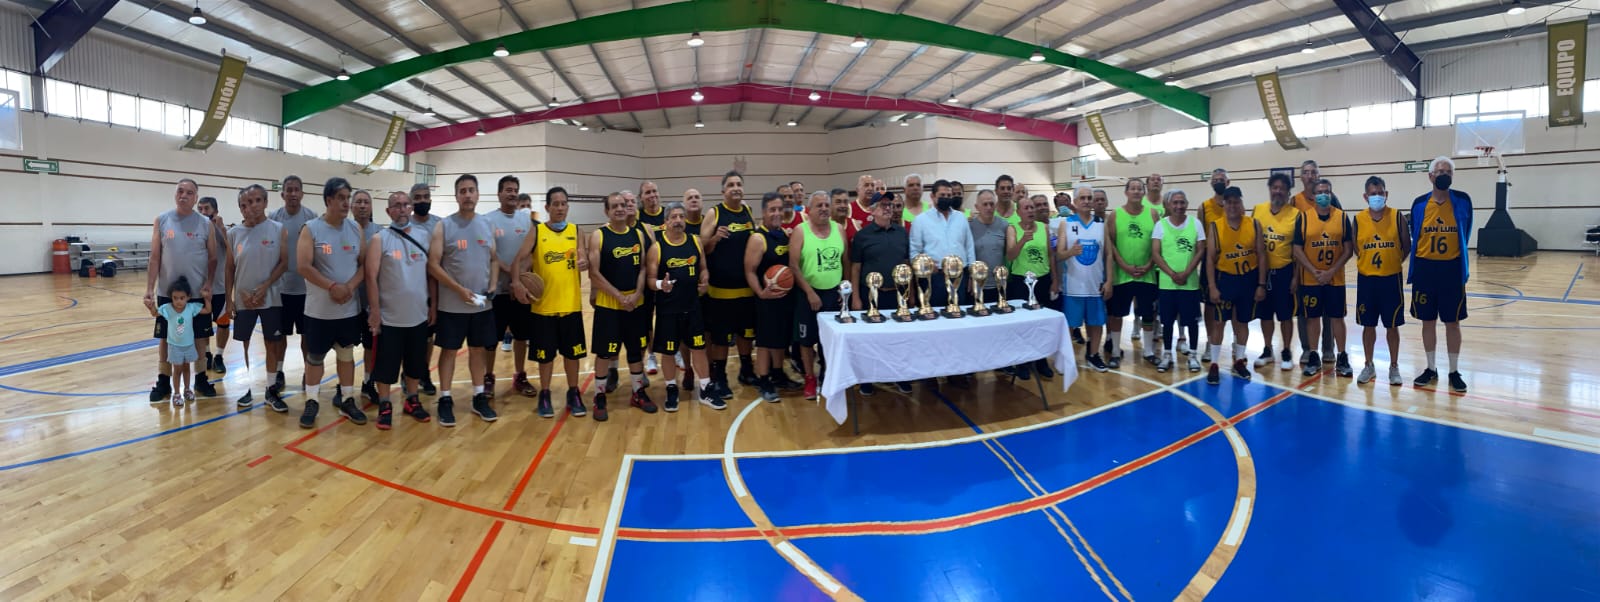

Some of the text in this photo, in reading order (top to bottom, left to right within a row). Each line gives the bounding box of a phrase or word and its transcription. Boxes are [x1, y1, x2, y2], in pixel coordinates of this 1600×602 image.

[1557, 39, 1576, 96] EQUIPO
[213, 76, 238, 120] UNIÓN
[1262, 79, 1287, 132] ESFUERZO
[1071, 225, 1079, 236] 4
[322, 243, 332, 255] 16
[457, 239, 468, 249] 10
[1430, 235, 1448, 255] 16
[1225, 252, 1240, 260] SAN
[1317, 249, 1335, 266] 49
[1371, 251, 1383, 269] 4
[1234, 260, 1251, 275] 10
[1415, 291, 1428, 305] 16
[1359, 304, 1366, 315] 4
[608, 342, 618, 353] 12
[666, 341, 675, 351] 11
[693, 335, 705, 347] NL
[572, 344, 587, 357] NL
